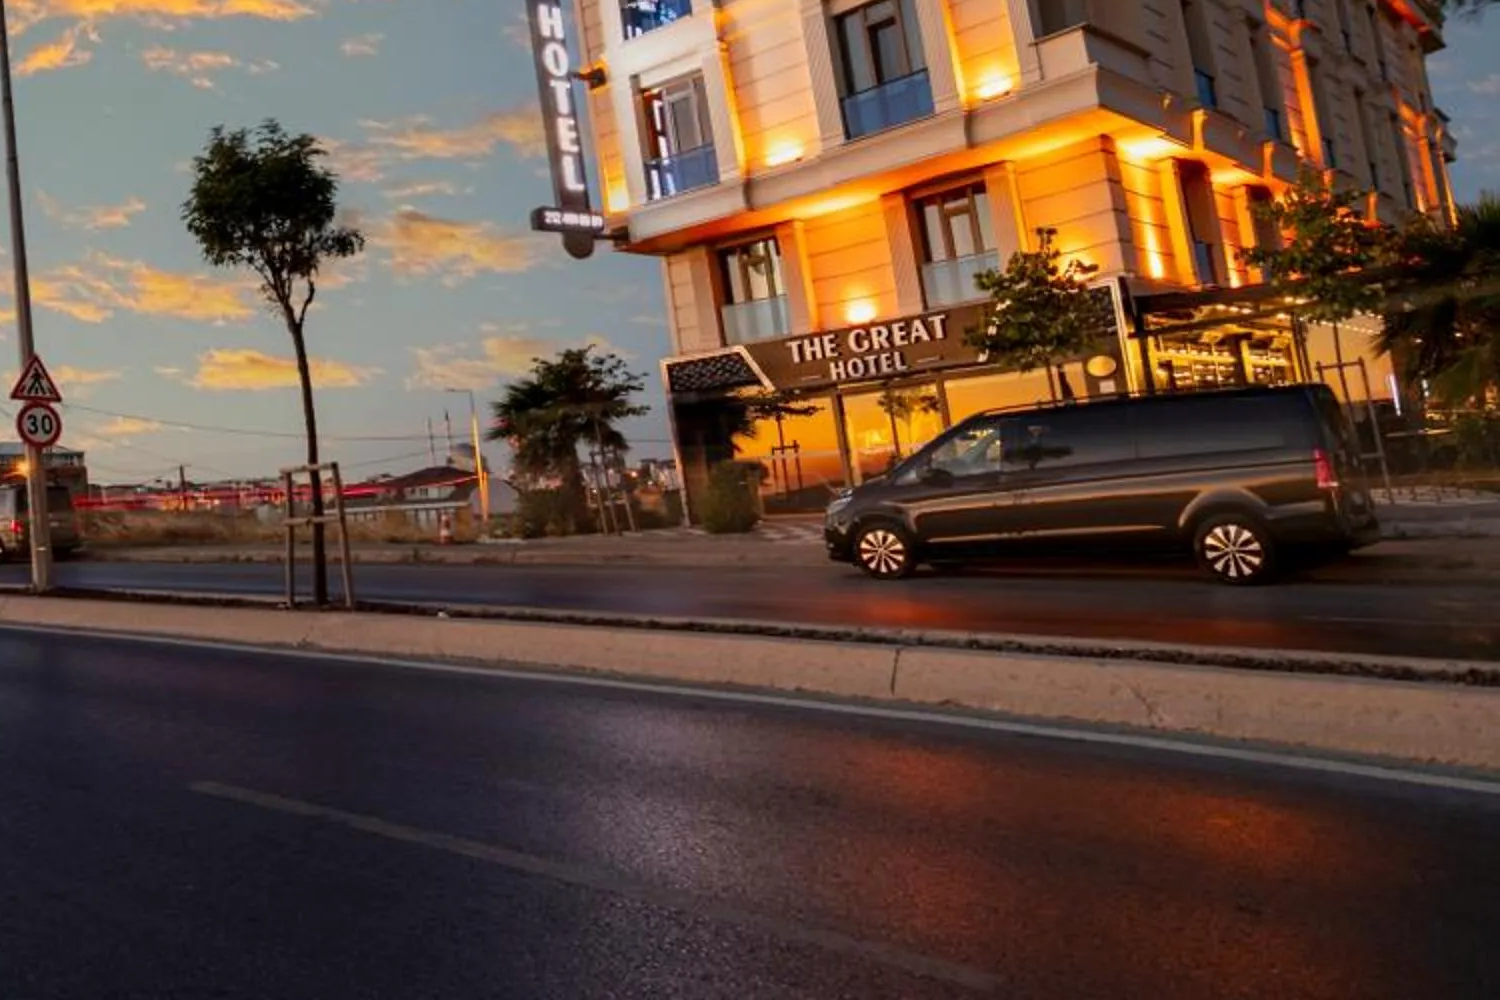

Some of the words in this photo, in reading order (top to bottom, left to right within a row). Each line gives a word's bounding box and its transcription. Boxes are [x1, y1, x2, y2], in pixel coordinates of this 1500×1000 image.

[537, 3, 585, 193] HOTEL
[785, 333, 839, 364] THE
[847, 314, 947, 353] GREAT
[829, 351, 908, 381] HOTEL
[27, 414, 53, 435] 30
